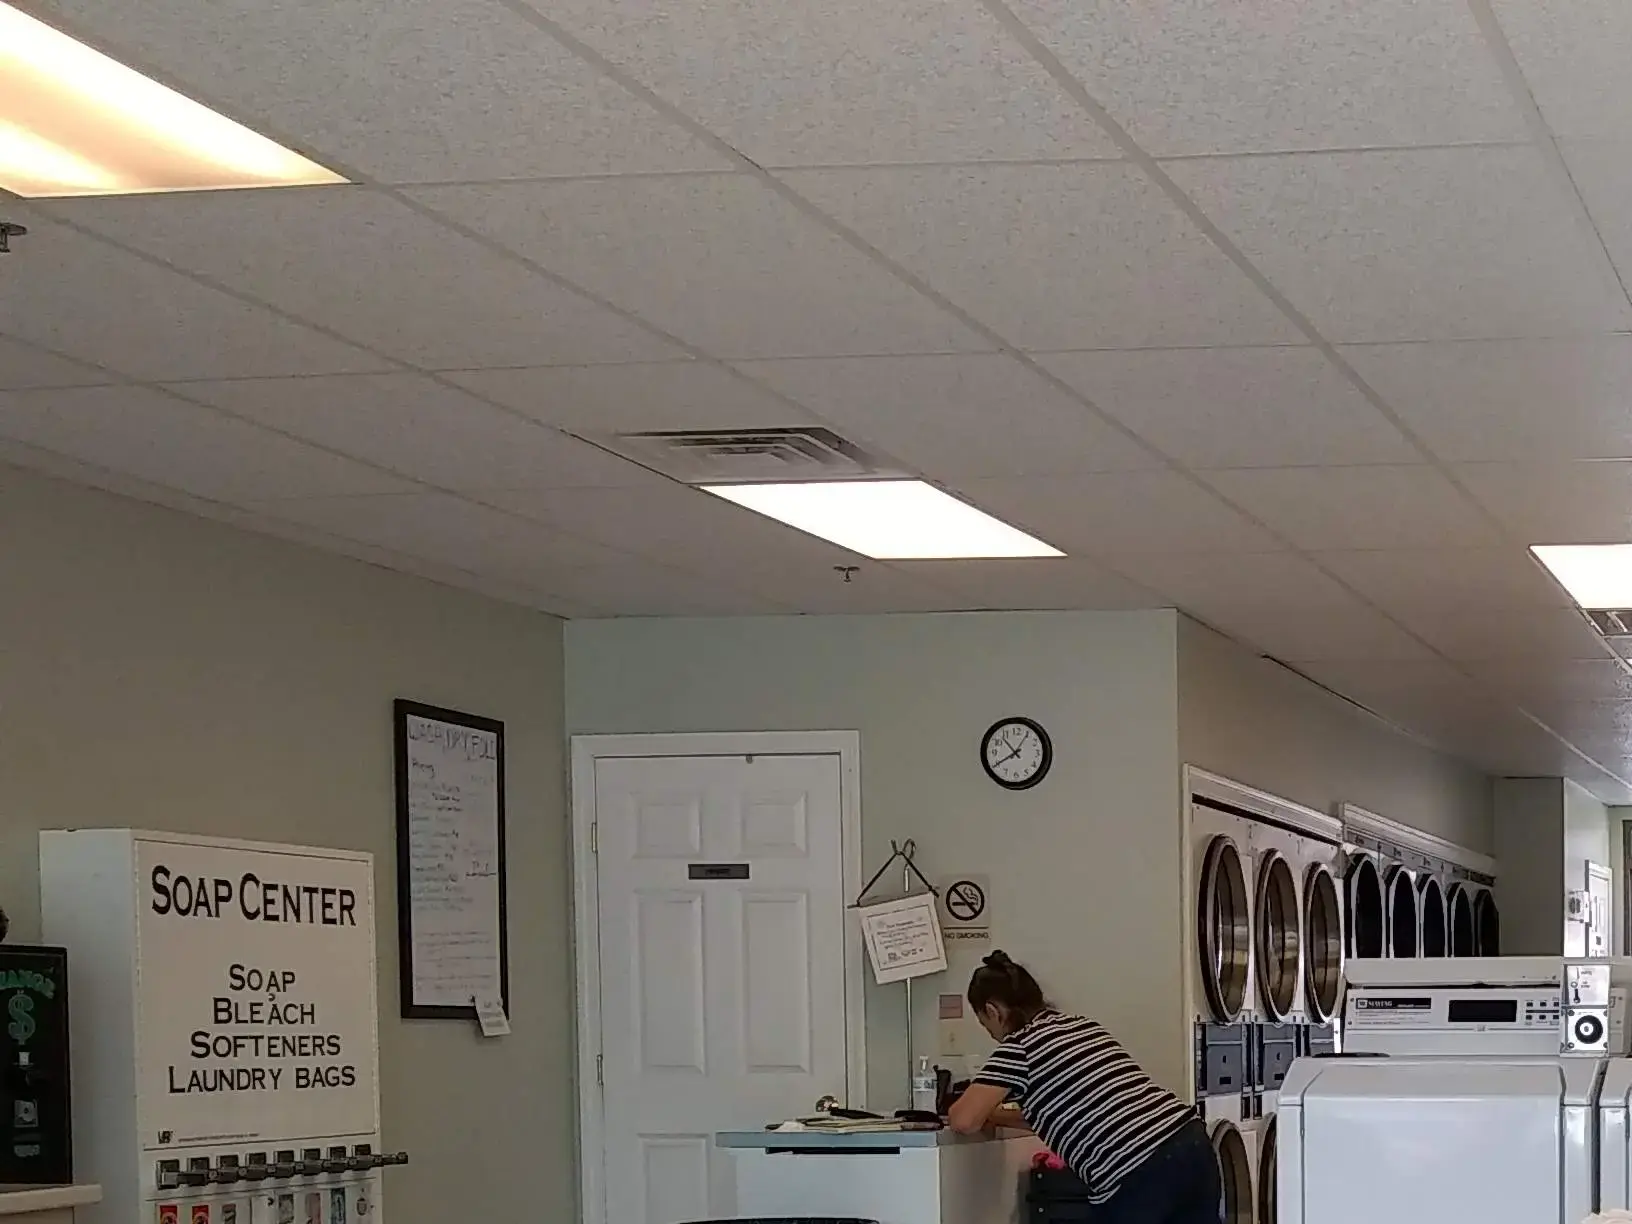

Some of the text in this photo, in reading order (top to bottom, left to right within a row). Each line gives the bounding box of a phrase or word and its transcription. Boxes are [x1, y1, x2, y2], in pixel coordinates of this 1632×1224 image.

[151, 865, 357, 926] SOAP CENTER
[956, 931, 989, 939] SMOKING
[229, 964, 296, 992] SOAP
[213, 997, 316, 1025] BLEACH
[190, 1031, 341, 1059] SOFTENERS
[168, 1066, 356, 1094] LAUNDRY BAGS
